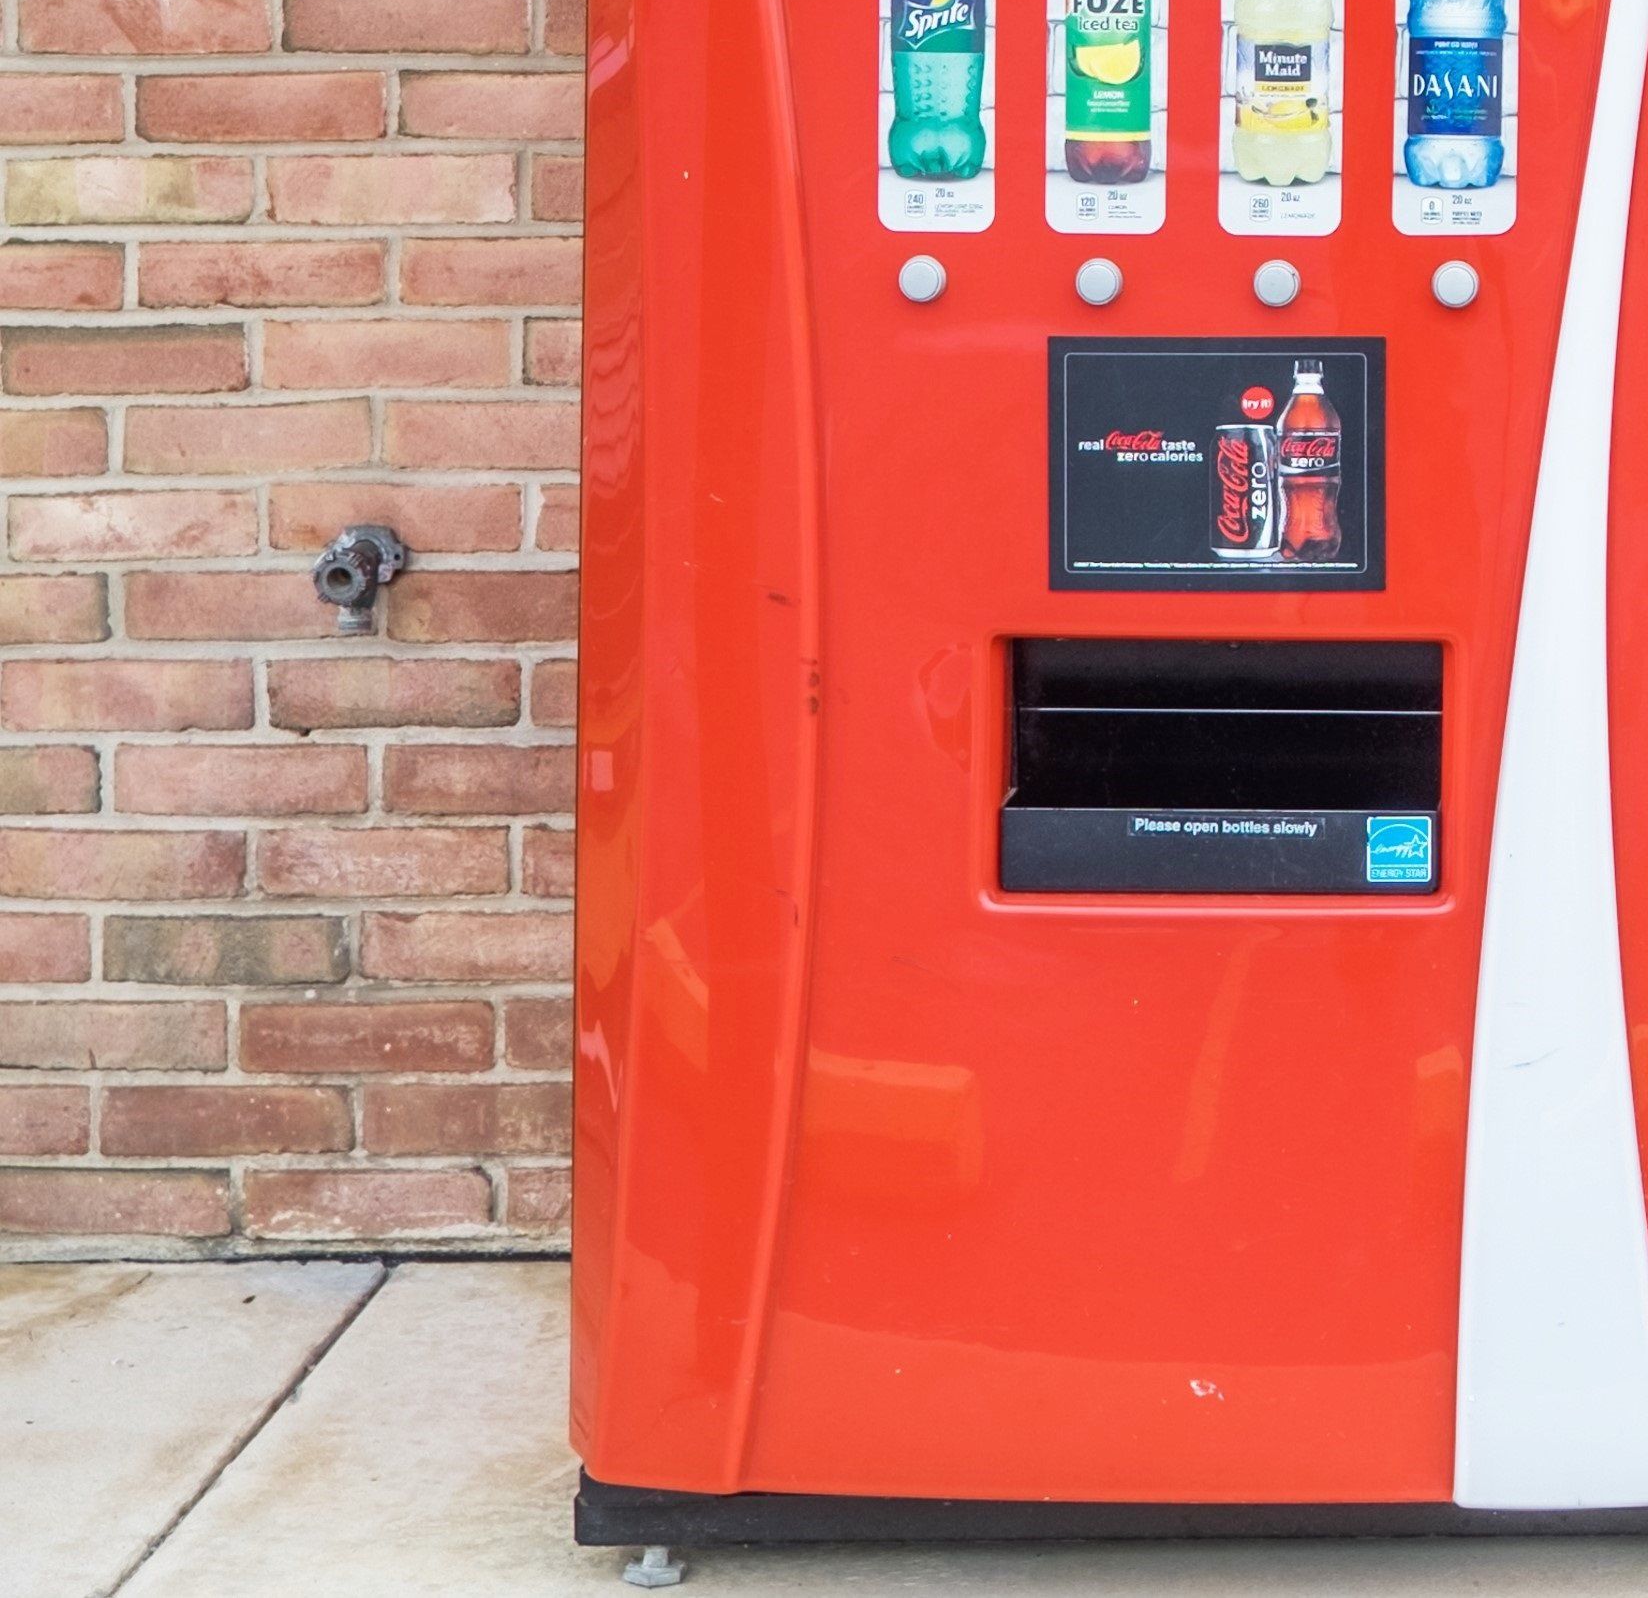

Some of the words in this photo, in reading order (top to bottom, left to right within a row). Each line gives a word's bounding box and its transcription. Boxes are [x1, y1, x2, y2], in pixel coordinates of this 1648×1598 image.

[905, 0, 969, 39] Sprite
[1079, 16, 1109, 30] iced
[1115, 17, 1139, 31] tea
[1259, 50, 1307, 64] Minute
[1264, 63, 1301, 76] Maid
[1413, 68, 1498, 100] DASANI
[1078, 439, 1104, 451] real
[1161, 440, 1196, 451] taste
[1117, 452, 1148, 462] zero
[1149, 451, 1203, 462] calories
[1290, 457, 1324, 468] zero
[1251, 462, 1267, 520] zero
[1134, 818, 1180, 832] Please
[1183, 821, 1218, 835] open
[1222, 819, 1269, 833] bottles
[1273, 818, 1317, 837] slowly
